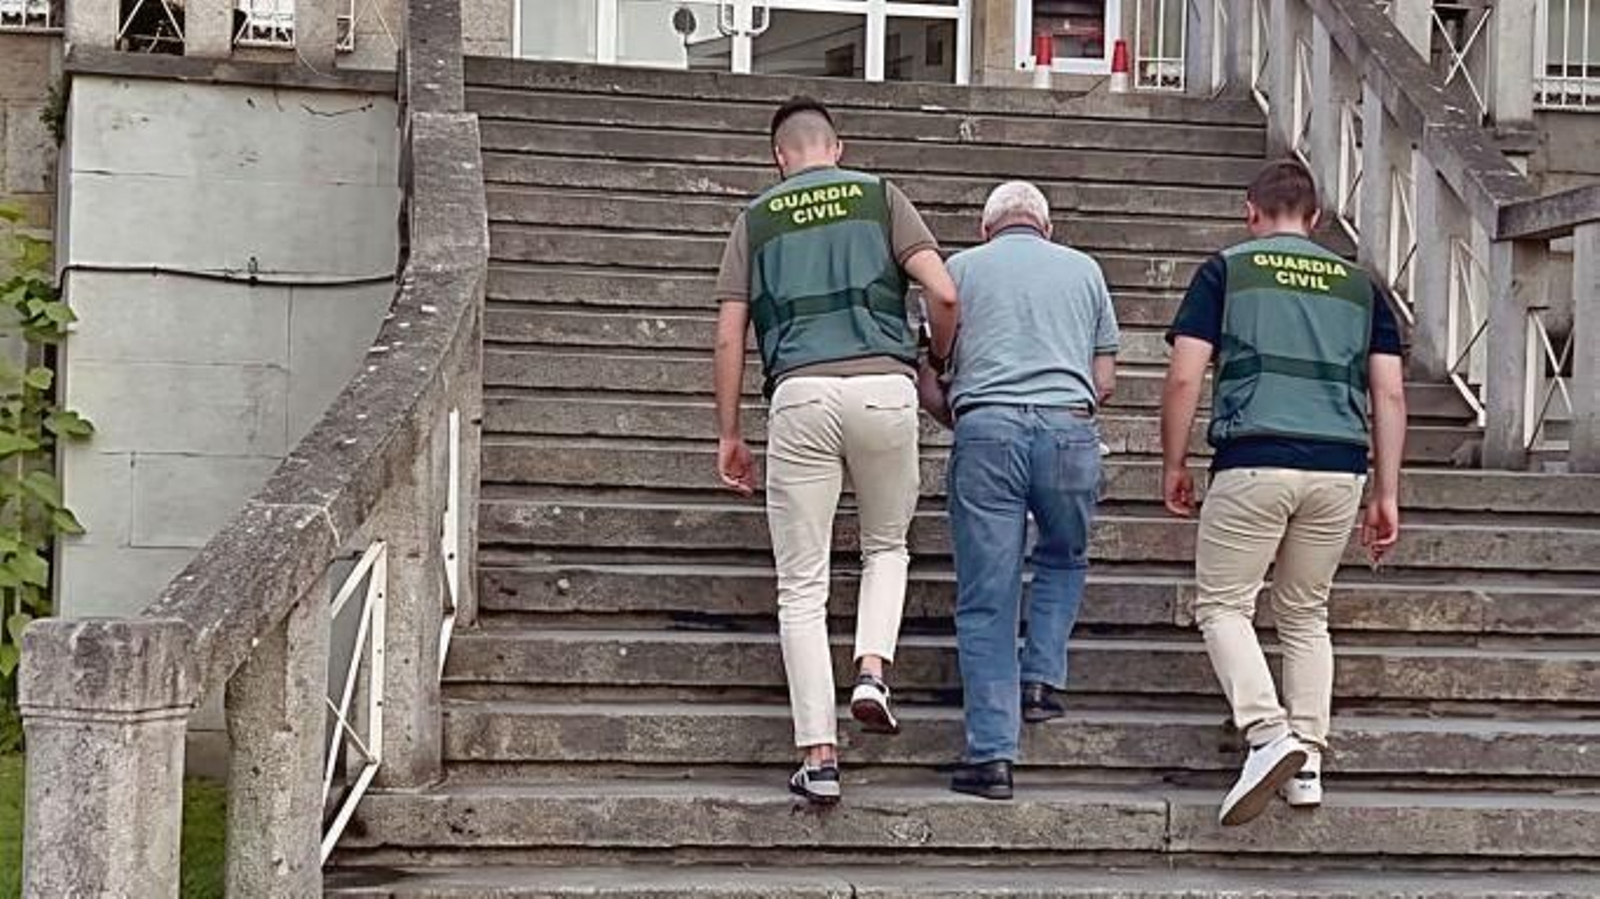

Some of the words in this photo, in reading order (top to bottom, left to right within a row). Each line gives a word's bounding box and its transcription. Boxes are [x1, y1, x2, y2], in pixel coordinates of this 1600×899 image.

[769, 184, 863, 211] GUARDIA
[792, 202, 847, 224] CIVIL
[1253, 254, 1347, 277] GUARDIA
[1275, 271, 1330, 291] CIVIL
